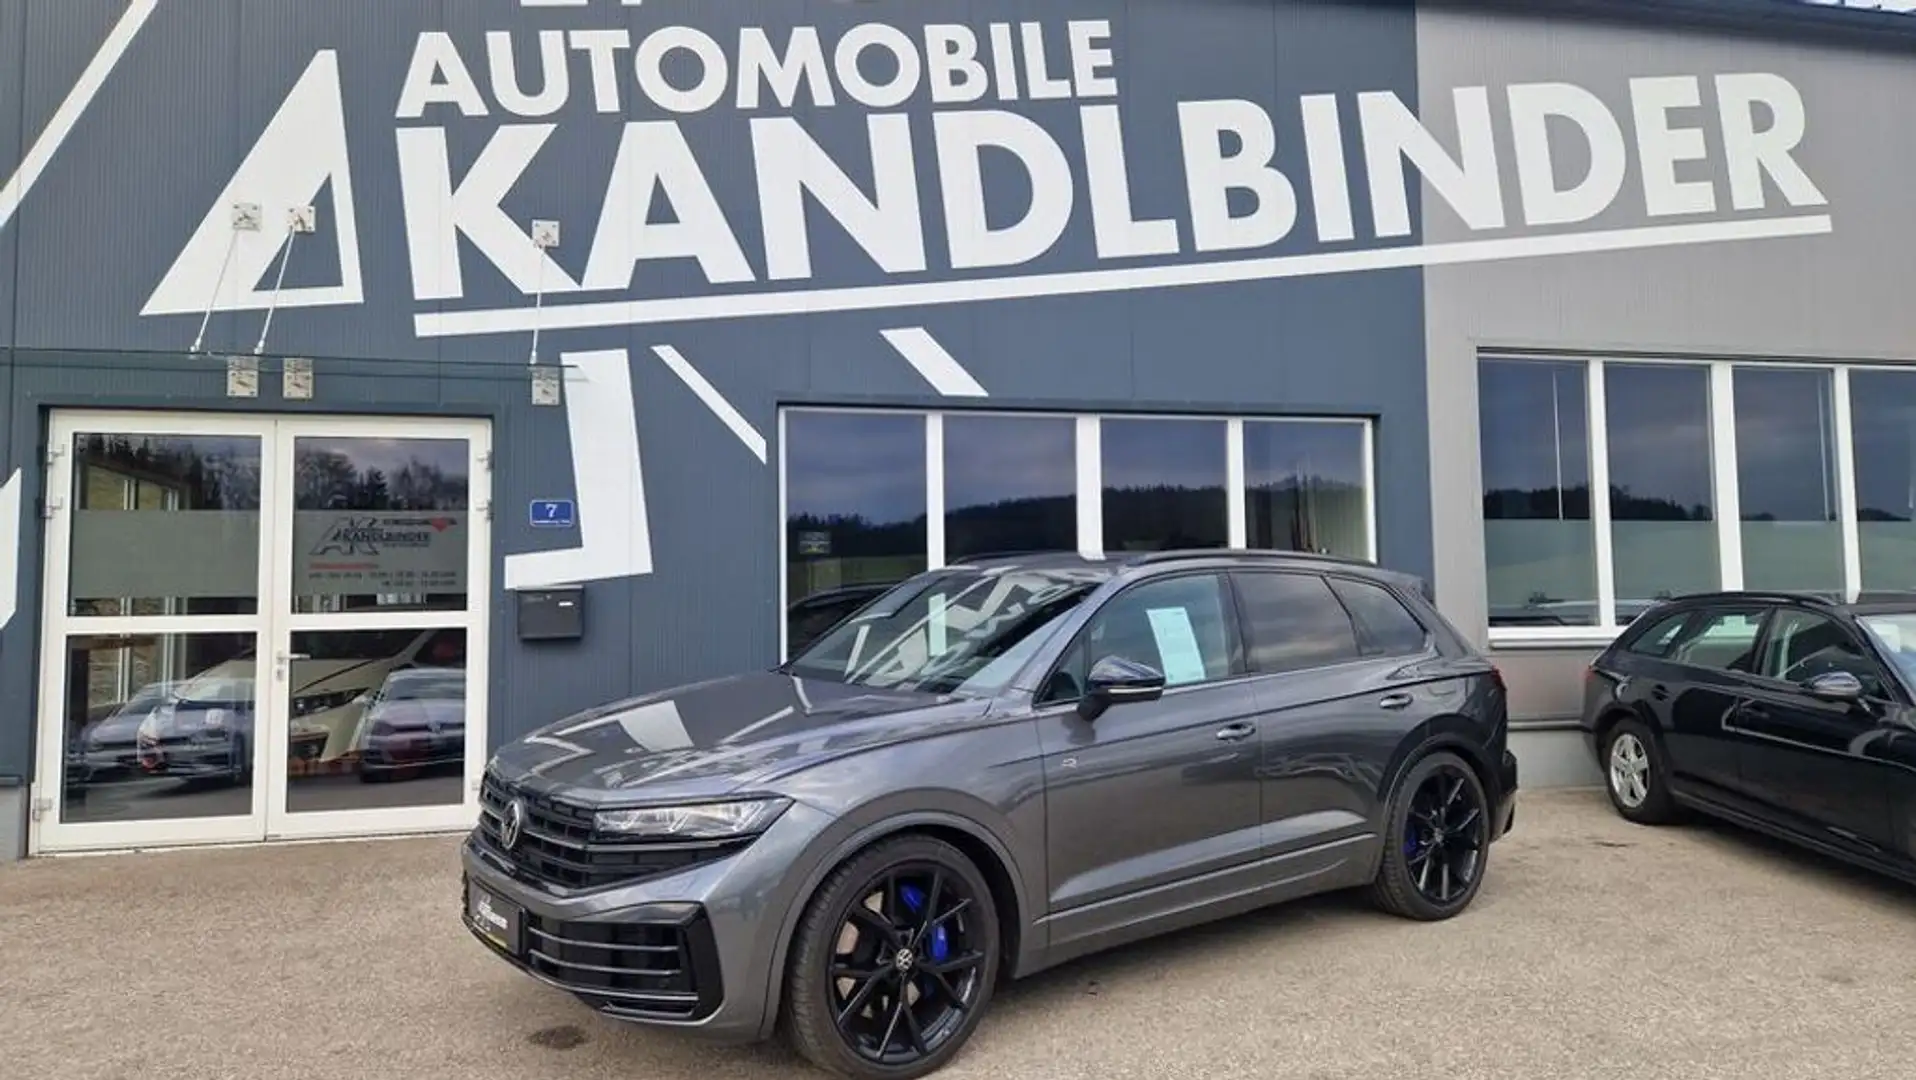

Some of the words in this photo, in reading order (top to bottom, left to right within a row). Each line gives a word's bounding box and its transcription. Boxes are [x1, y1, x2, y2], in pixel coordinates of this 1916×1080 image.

[395, 20, 1118, 117] AUTOMOBILE
[396, 72, 1828, 300] KANDLBINDER
[545, 503, 558, 518] 7
